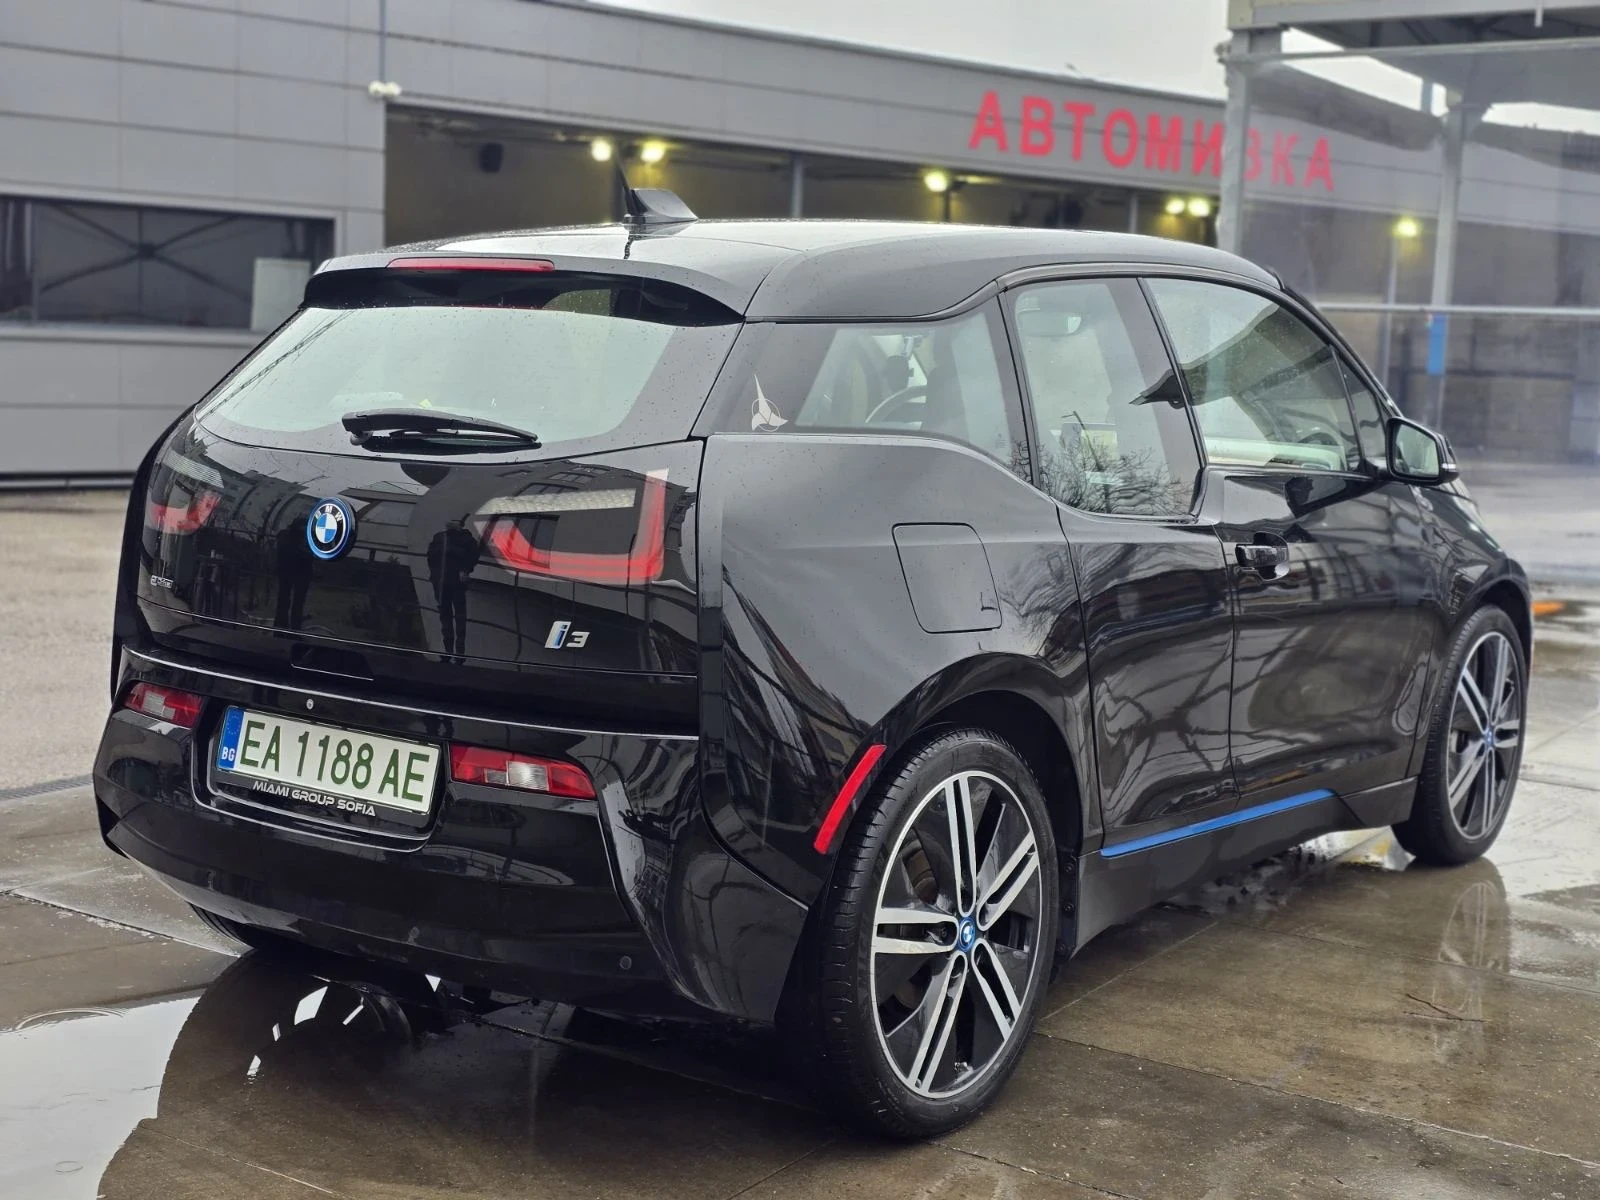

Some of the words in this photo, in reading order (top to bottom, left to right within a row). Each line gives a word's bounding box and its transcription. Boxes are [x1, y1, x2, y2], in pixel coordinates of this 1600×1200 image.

[313, 504, 343, 522] BMW
[544, 620, 590, 649] i3
[221, 746, 235, 762] BG
[239, 719, 281, 773] EA
[296, 730, 374, 790] 1188
[377, 748, 430, 803] AE
[252, 780, 290, 797] MIAMI
[291, 785, 335, 807] GROUP
[336, 798, 376, 817] SOFIA
